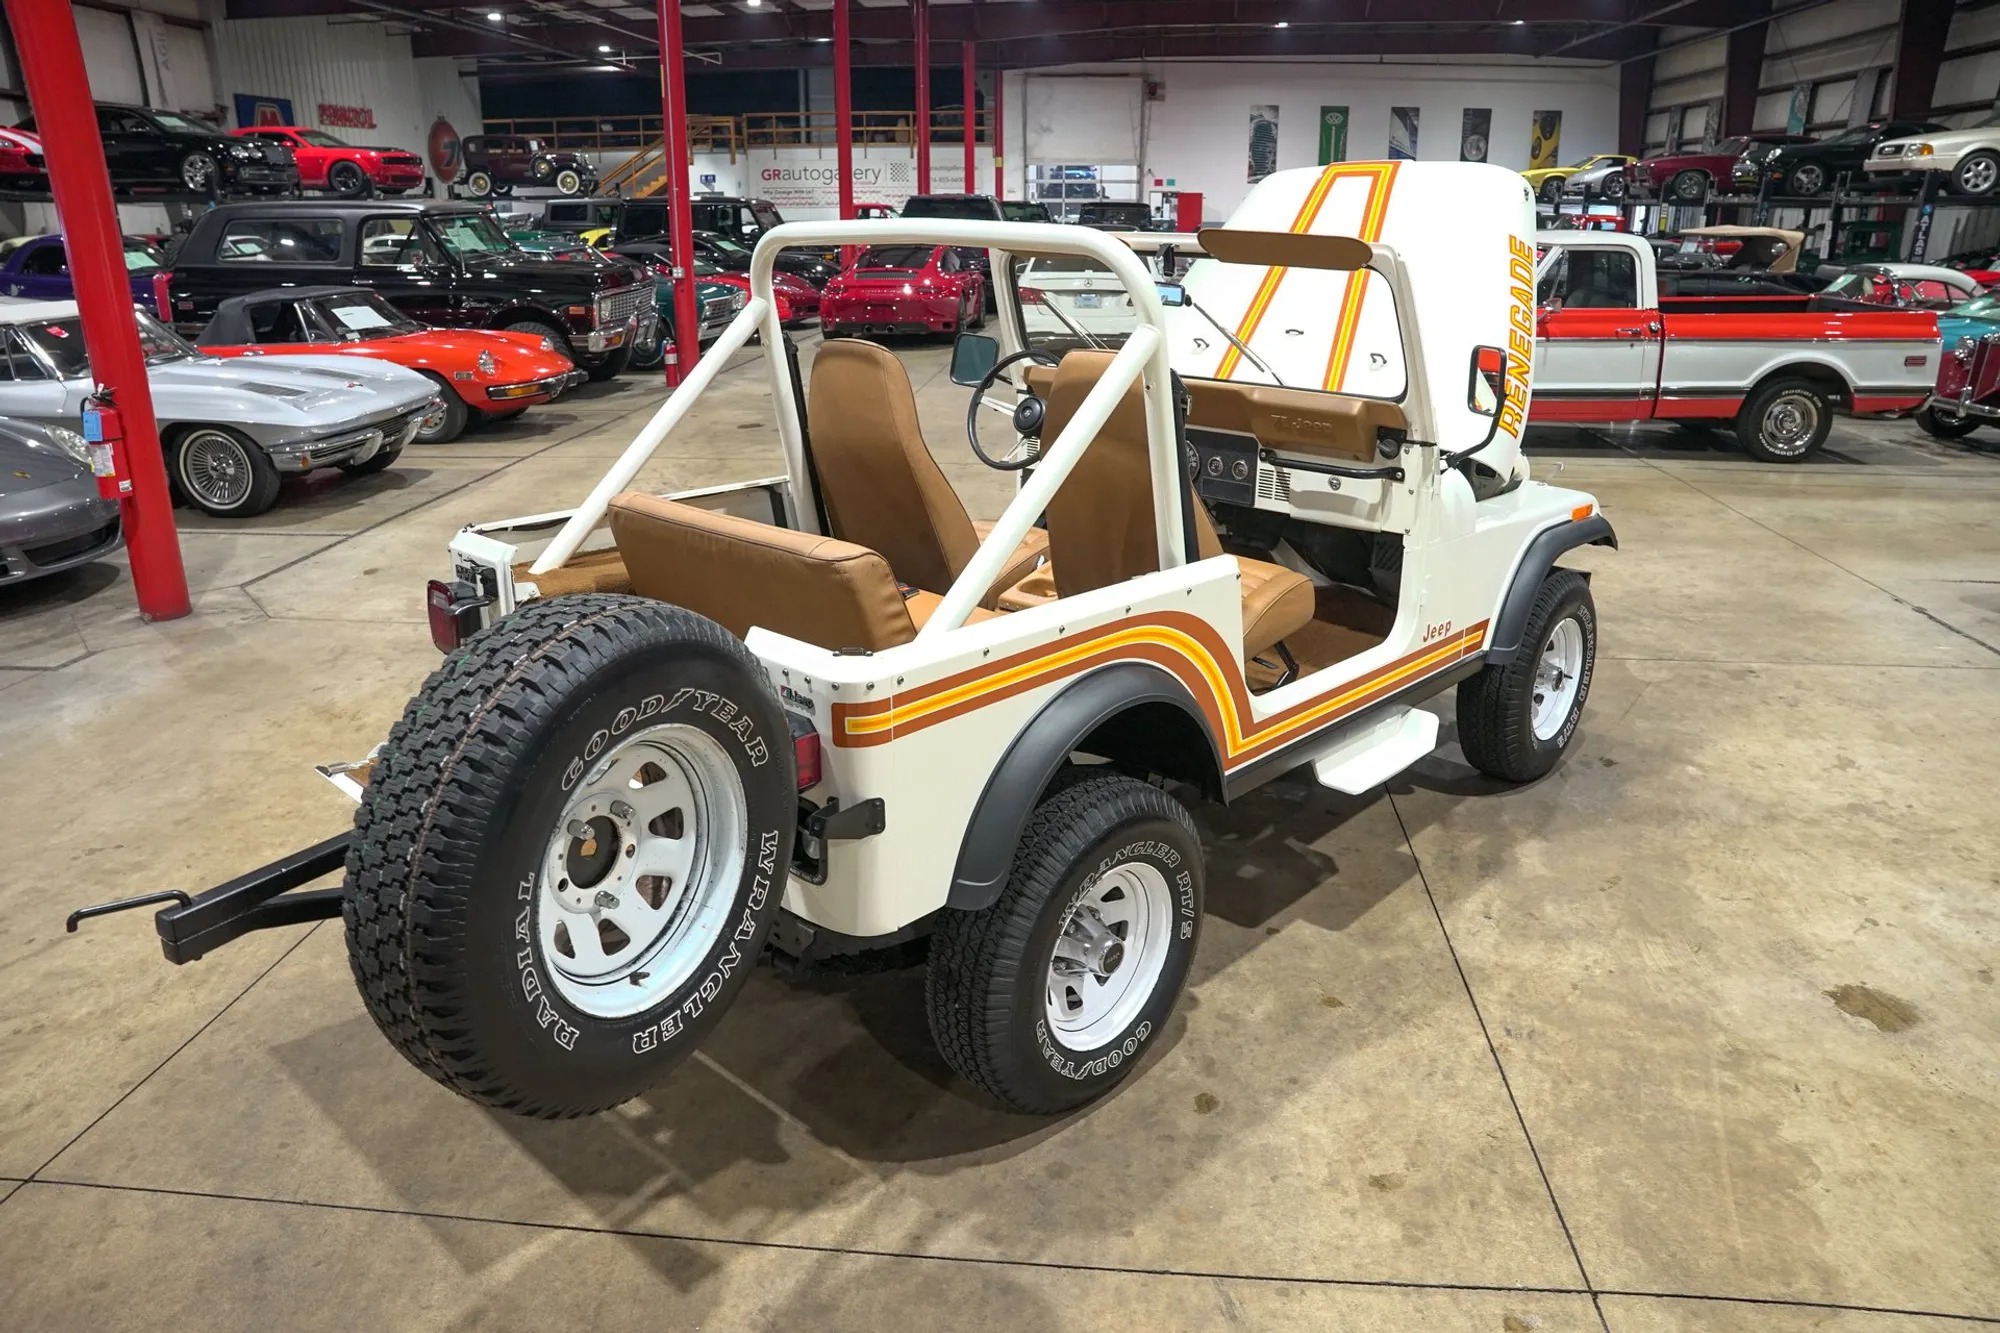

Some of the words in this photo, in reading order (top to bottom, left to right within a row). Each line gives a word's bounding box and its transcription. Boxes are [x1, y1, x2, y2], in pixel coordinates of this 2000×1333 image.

[1913, 215, 1932, 256] ATLAS
[1498, 233, 1534, 440] RENEGADE
[1291, 417, 1334, 434] Jeep
[1422, 619, 1453, 644] Jeep
[516, 871, 580, 1051] RADIAL
[632, 830, 779, 1054] WRANGLER
